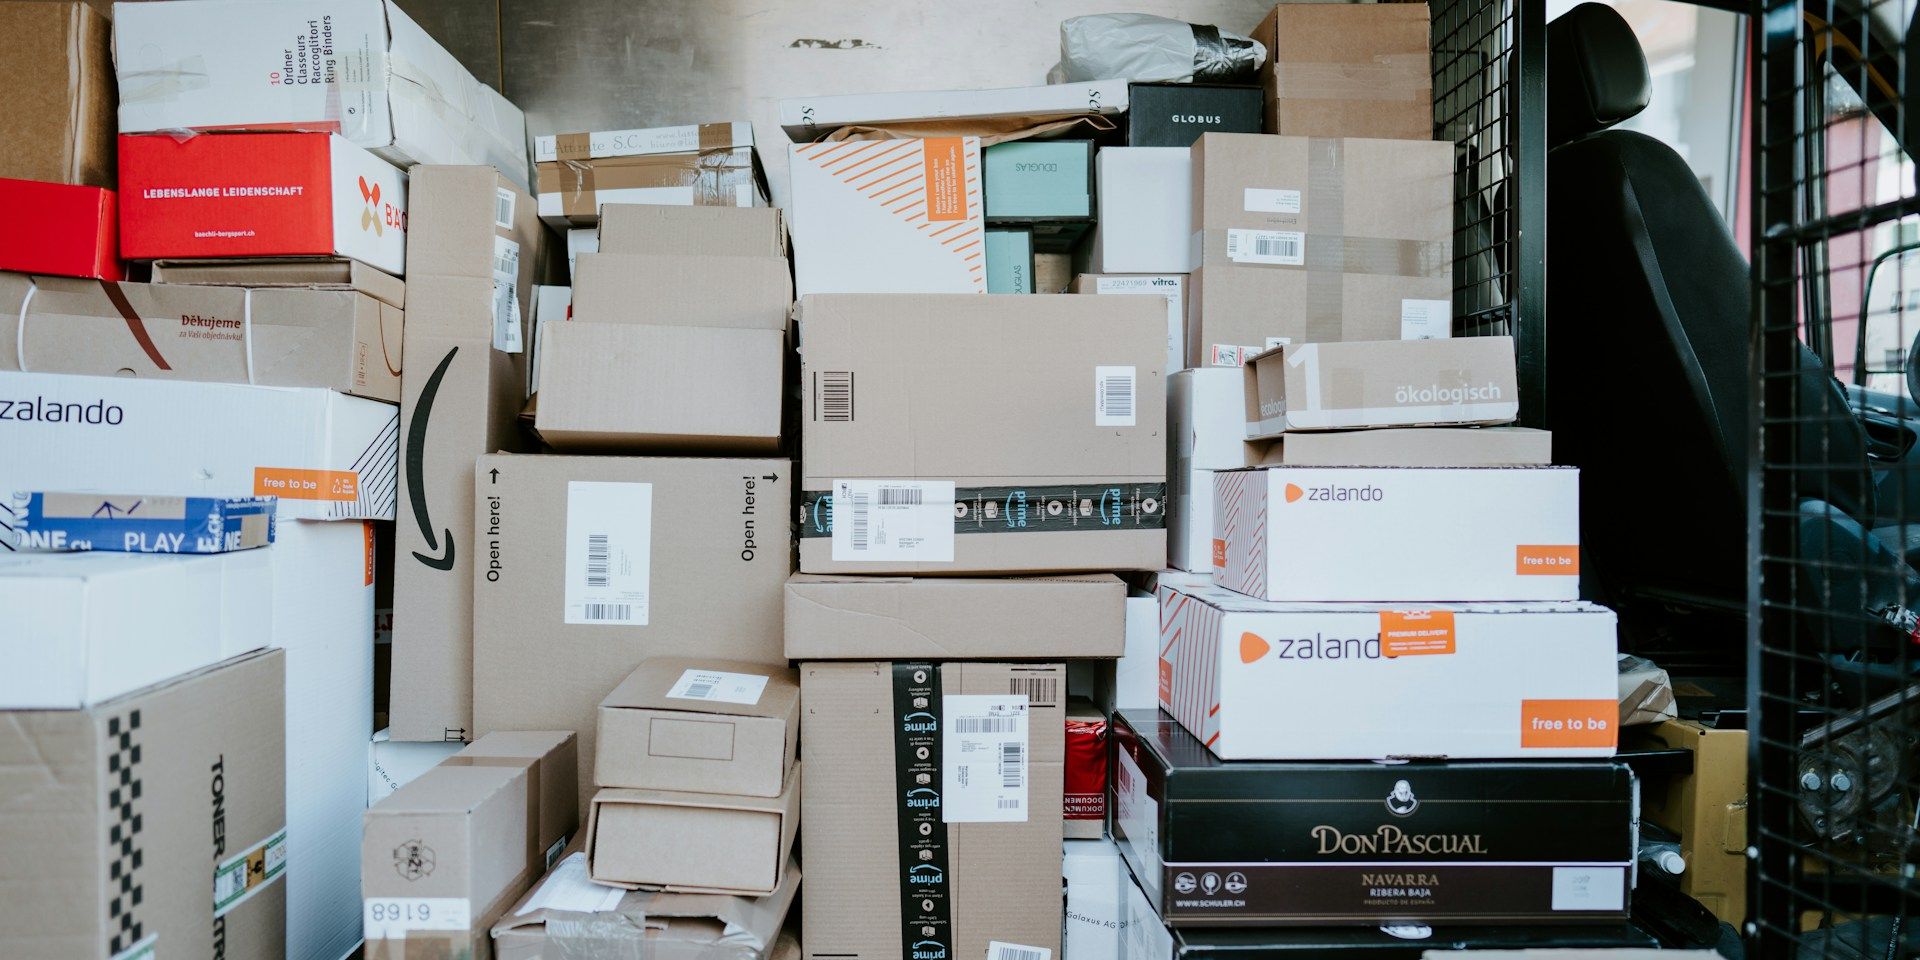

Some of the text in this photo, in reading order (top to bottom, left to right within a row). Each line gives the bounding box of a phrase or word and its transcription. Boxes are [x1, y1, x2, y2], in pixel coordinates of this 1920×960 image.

[308, 20, 321, 84] Raccoglitori
[322, 15, 336, 84] Ring Binders
[283, 48, 294, 85] Ordner
[297, 35, 308, 85] Classeurs
[271, 72, 280, 86] 10
[1172, 115, 1221, 124] GLOBUS
[1015, 163, 1057, 172] DOUGLAS
[143, 186, 303, 199] LEBENSLANGE LEIDENSCHAFT
[194, 230, 255, 238] baechli-bergsport.ch
[1152, 278, 1178, 286] vitra.
[182, 314, 241, 330] Děkujeme
[1395, 382, 1501, 404] ökologisch
[0, 396, 123, 425] zalando
[263, 477, 316, 489] free to be
[1308, 482, 1383, 501] zalando
[1014, 491, 1028, 527] prime
[1107, 488, 1122, 525] prime
[741, 475, 757, 561] Open here!
[125, 532, 184, 553] PLAY
[486, 495, 503, 582] Open here!
[1523, 555, 1571, 566] free to be
[1417, 629, 1448, 637] DELIVERY
[1279, 632, 1398, 661] zaland
[904, 720, 937, 733] prime
[1532, 717, 1607, 730] free to be
[211, 754, 226, 860] TONER
[907, 797, 940, 809] prime
[910, 873, 943, 886] prime
[1362, 873, 1439, 886] NAVARRA
[1370, 888, 1431, 898] RIBERA BAJA
[1176, 899, 1246, 907] WWW.SCHULER.CH
[371, 903, 431, 922] 6168
[1066, 911, 1101, 925] Galaxus
[1103, 920, 1116, 929] AG
[912, 948, 946, 960] prime
